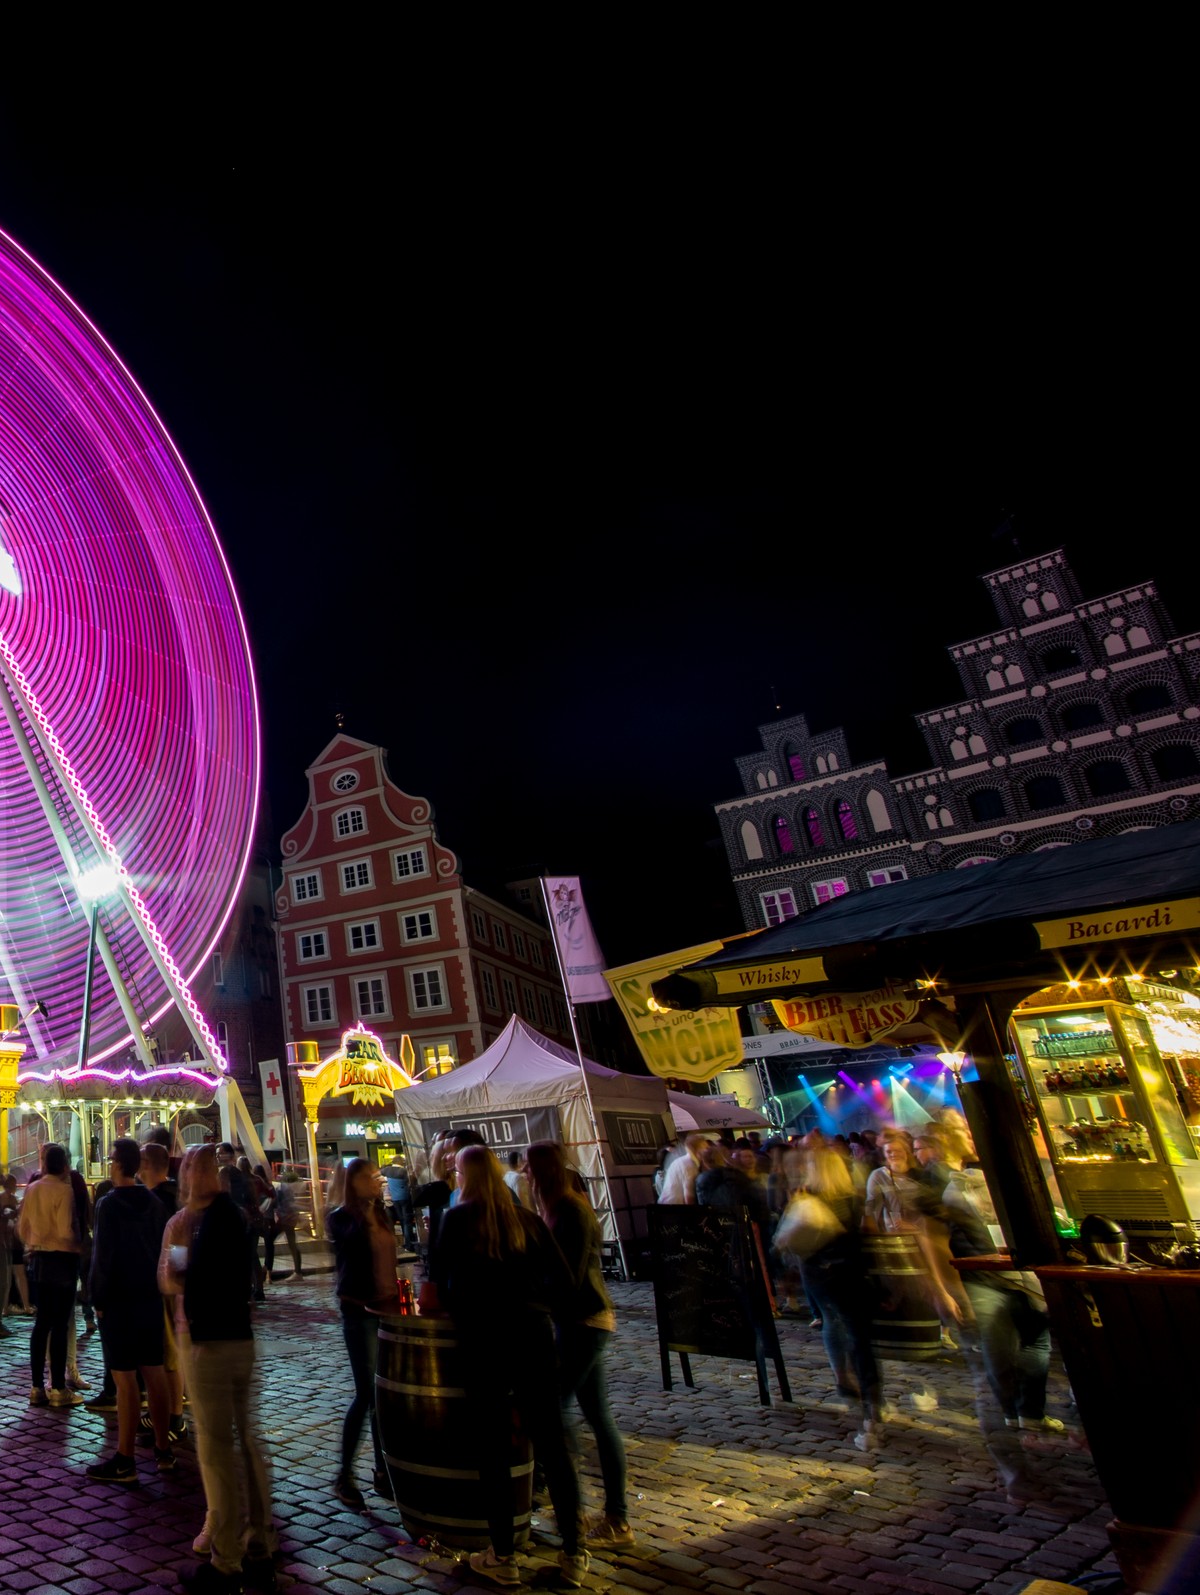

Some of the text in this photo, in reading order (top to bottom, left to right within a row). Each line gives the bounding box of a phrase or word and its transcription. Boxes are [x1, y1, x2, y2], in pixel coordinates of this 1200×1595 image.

[1067, 907, 1174, 940] Bacardi
[738, 966, 801, 986] Whisky
[783, 995, 843, 1028] BIER
[847, 1002, 908, 1034] FASS
[637, 1018, 737, 1068] Wein
[339, 1060, 393, 1091] BERLIN
[626, 1122, 649, 1144] HOLD
